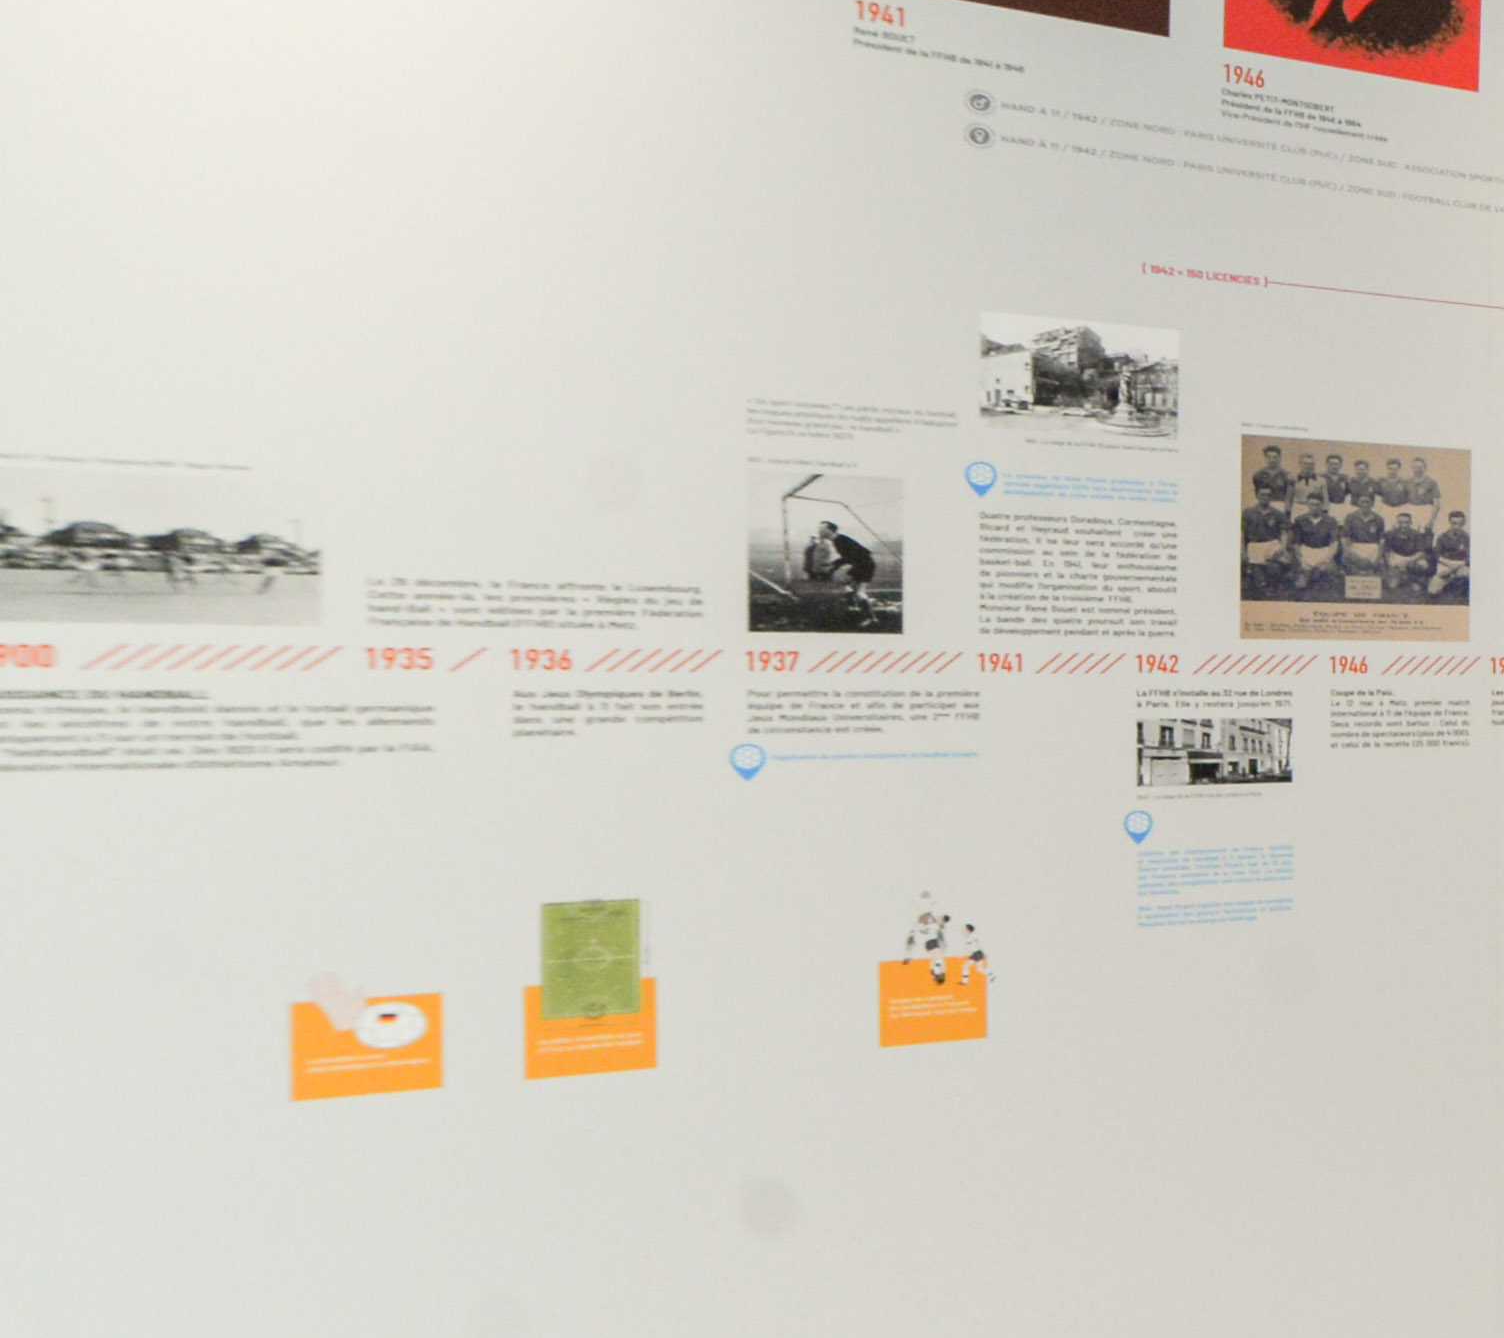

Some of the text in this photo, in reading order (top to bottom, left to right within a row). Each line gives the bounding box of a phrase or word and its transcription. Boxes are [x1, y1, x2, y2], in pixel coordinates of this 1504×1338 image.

[856, 0, 905, 27] 1941
[853, 38, 902, 54] Président
[1224, 64, 1264, 88] 1946
[1221, 87, 1252, 100] Charles
[1221, 98, 1261, 113] Président
[1263, 105, 1272, 114] de
[1275, 107, 1282, 115] la
[1307, 113, 1316, 121] de
[1001, 101, 1035, 115] HAND
[1110, 118, 1140, 130] ZONE
[1143, 122, 1175, 136] NORD
[1184, 130, 1214, 142] PARIS
[1281, 144, 1307, 156] CLUB
[1348, 154, 1374, 167] ZONE
[1404, 162, 1467, 179] ASSOCIATION
[1000, 134, 1035, 148] HAND
[1109, 149, 1139, 162] ZONE
[1142, 154, 1174, 168] NORD
[1183, 160, 1214, 172] PARIS
[1280, 175, 1306, 186] CLUB
[1347, 184, 1373, 195] ZONE
[1377, 188, 1396, 199] SUD
[1403, 193, 1450, 207] FOOTBALL
[1453, 200, 1477, 210] CLUB
[1150, 264, 1175, 276] 1942
[1187, 268, 1203, 280] 150
[366, 646, 434, 670] 1935
[511, 648, 573, 671] 1936
[746, 650, 800, 672] 1937
[978, 652, 1023, 672] 1941
[1136, 654, 1179, 673] 1942
[1330, 655, 1369, 674] 1946
[1330, 689, 1355, 698] Coupe
